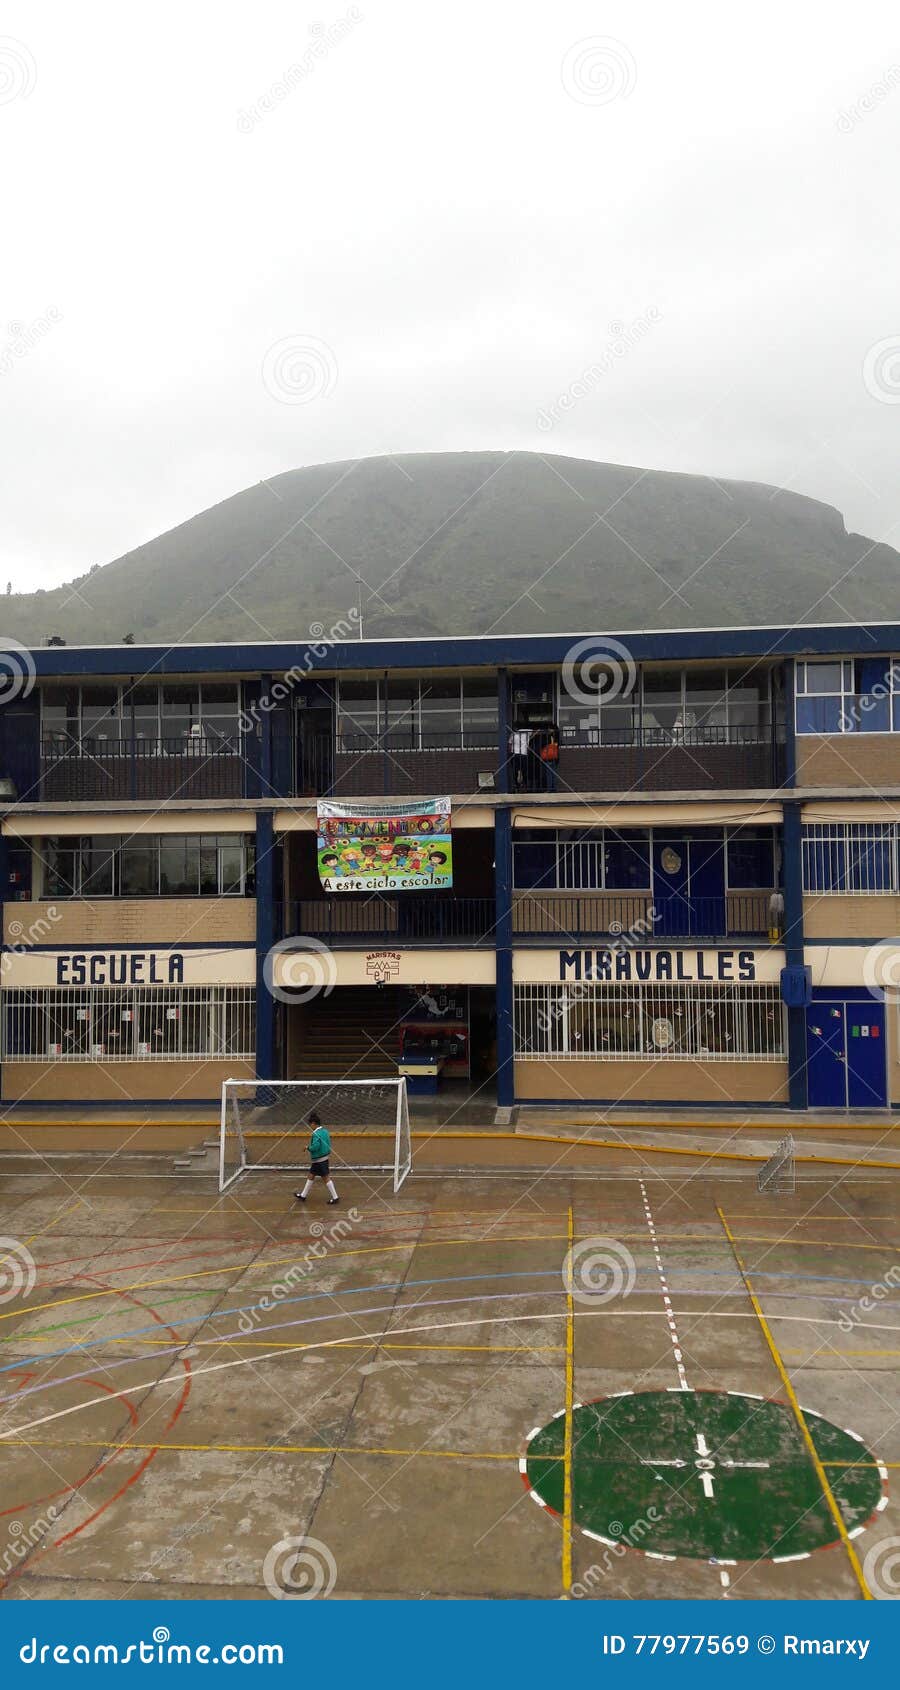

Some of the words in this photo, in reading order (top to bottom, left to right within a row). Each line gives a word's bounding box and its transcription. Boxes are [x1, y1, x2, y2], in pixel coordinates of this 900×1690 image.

[323, 878, 333, 889] A
[337, 879, 363, 890] este
[366, 875, 396, 889] ciclo
[401, 873, 449, 887] escolar
[366, 951, 401, 961] MARISTAS
[559, 950, 755, 981] MIRAVALLES
[56, 953, 184, 985] ESCUELA
